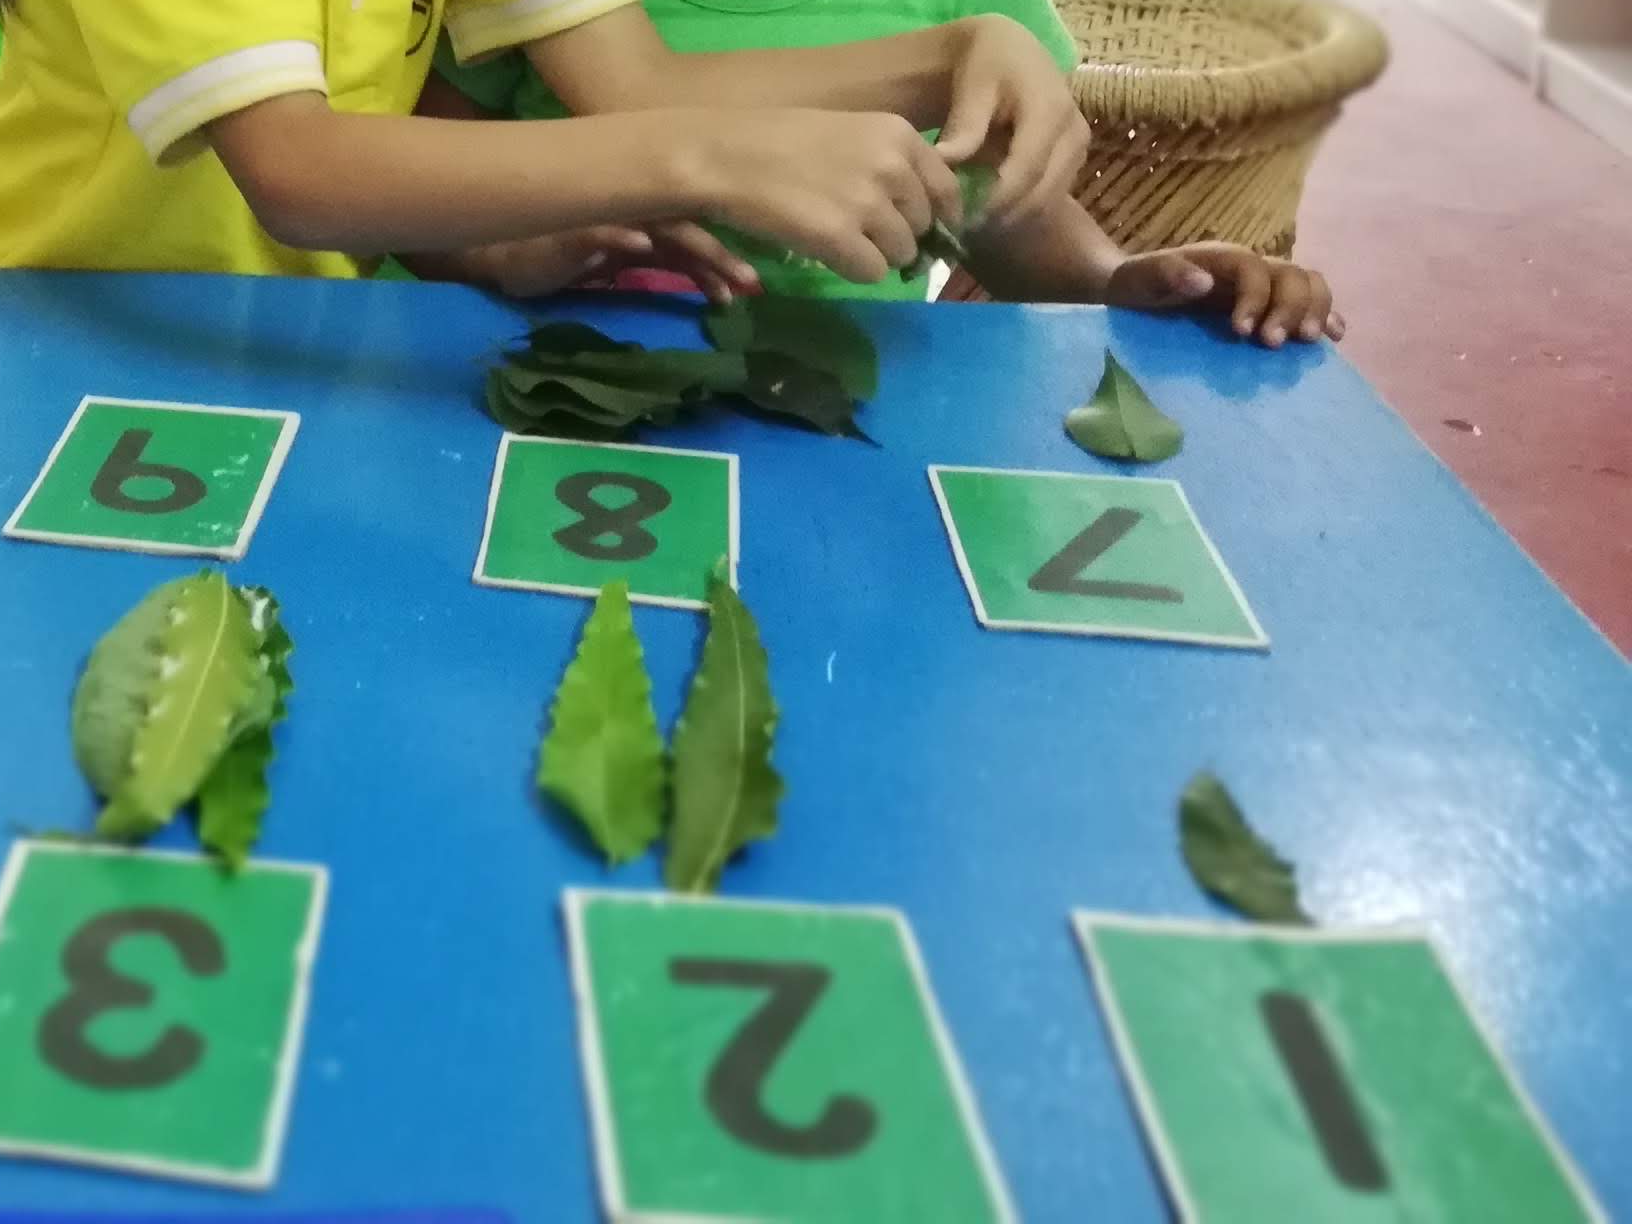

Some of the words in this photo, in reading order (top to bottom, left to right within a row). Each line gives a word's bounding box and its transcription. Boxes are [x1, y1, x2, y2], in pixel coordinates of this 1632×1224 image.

[90, 429, 207, 514] 9
[552, 471, 672, 561] 8
[1027, 507, 1183, 603] 7
[37, 906, 226, 1092] 3
[668, 957, 878, 1160] 2
[1259, 990, 1390, 1193] 1
